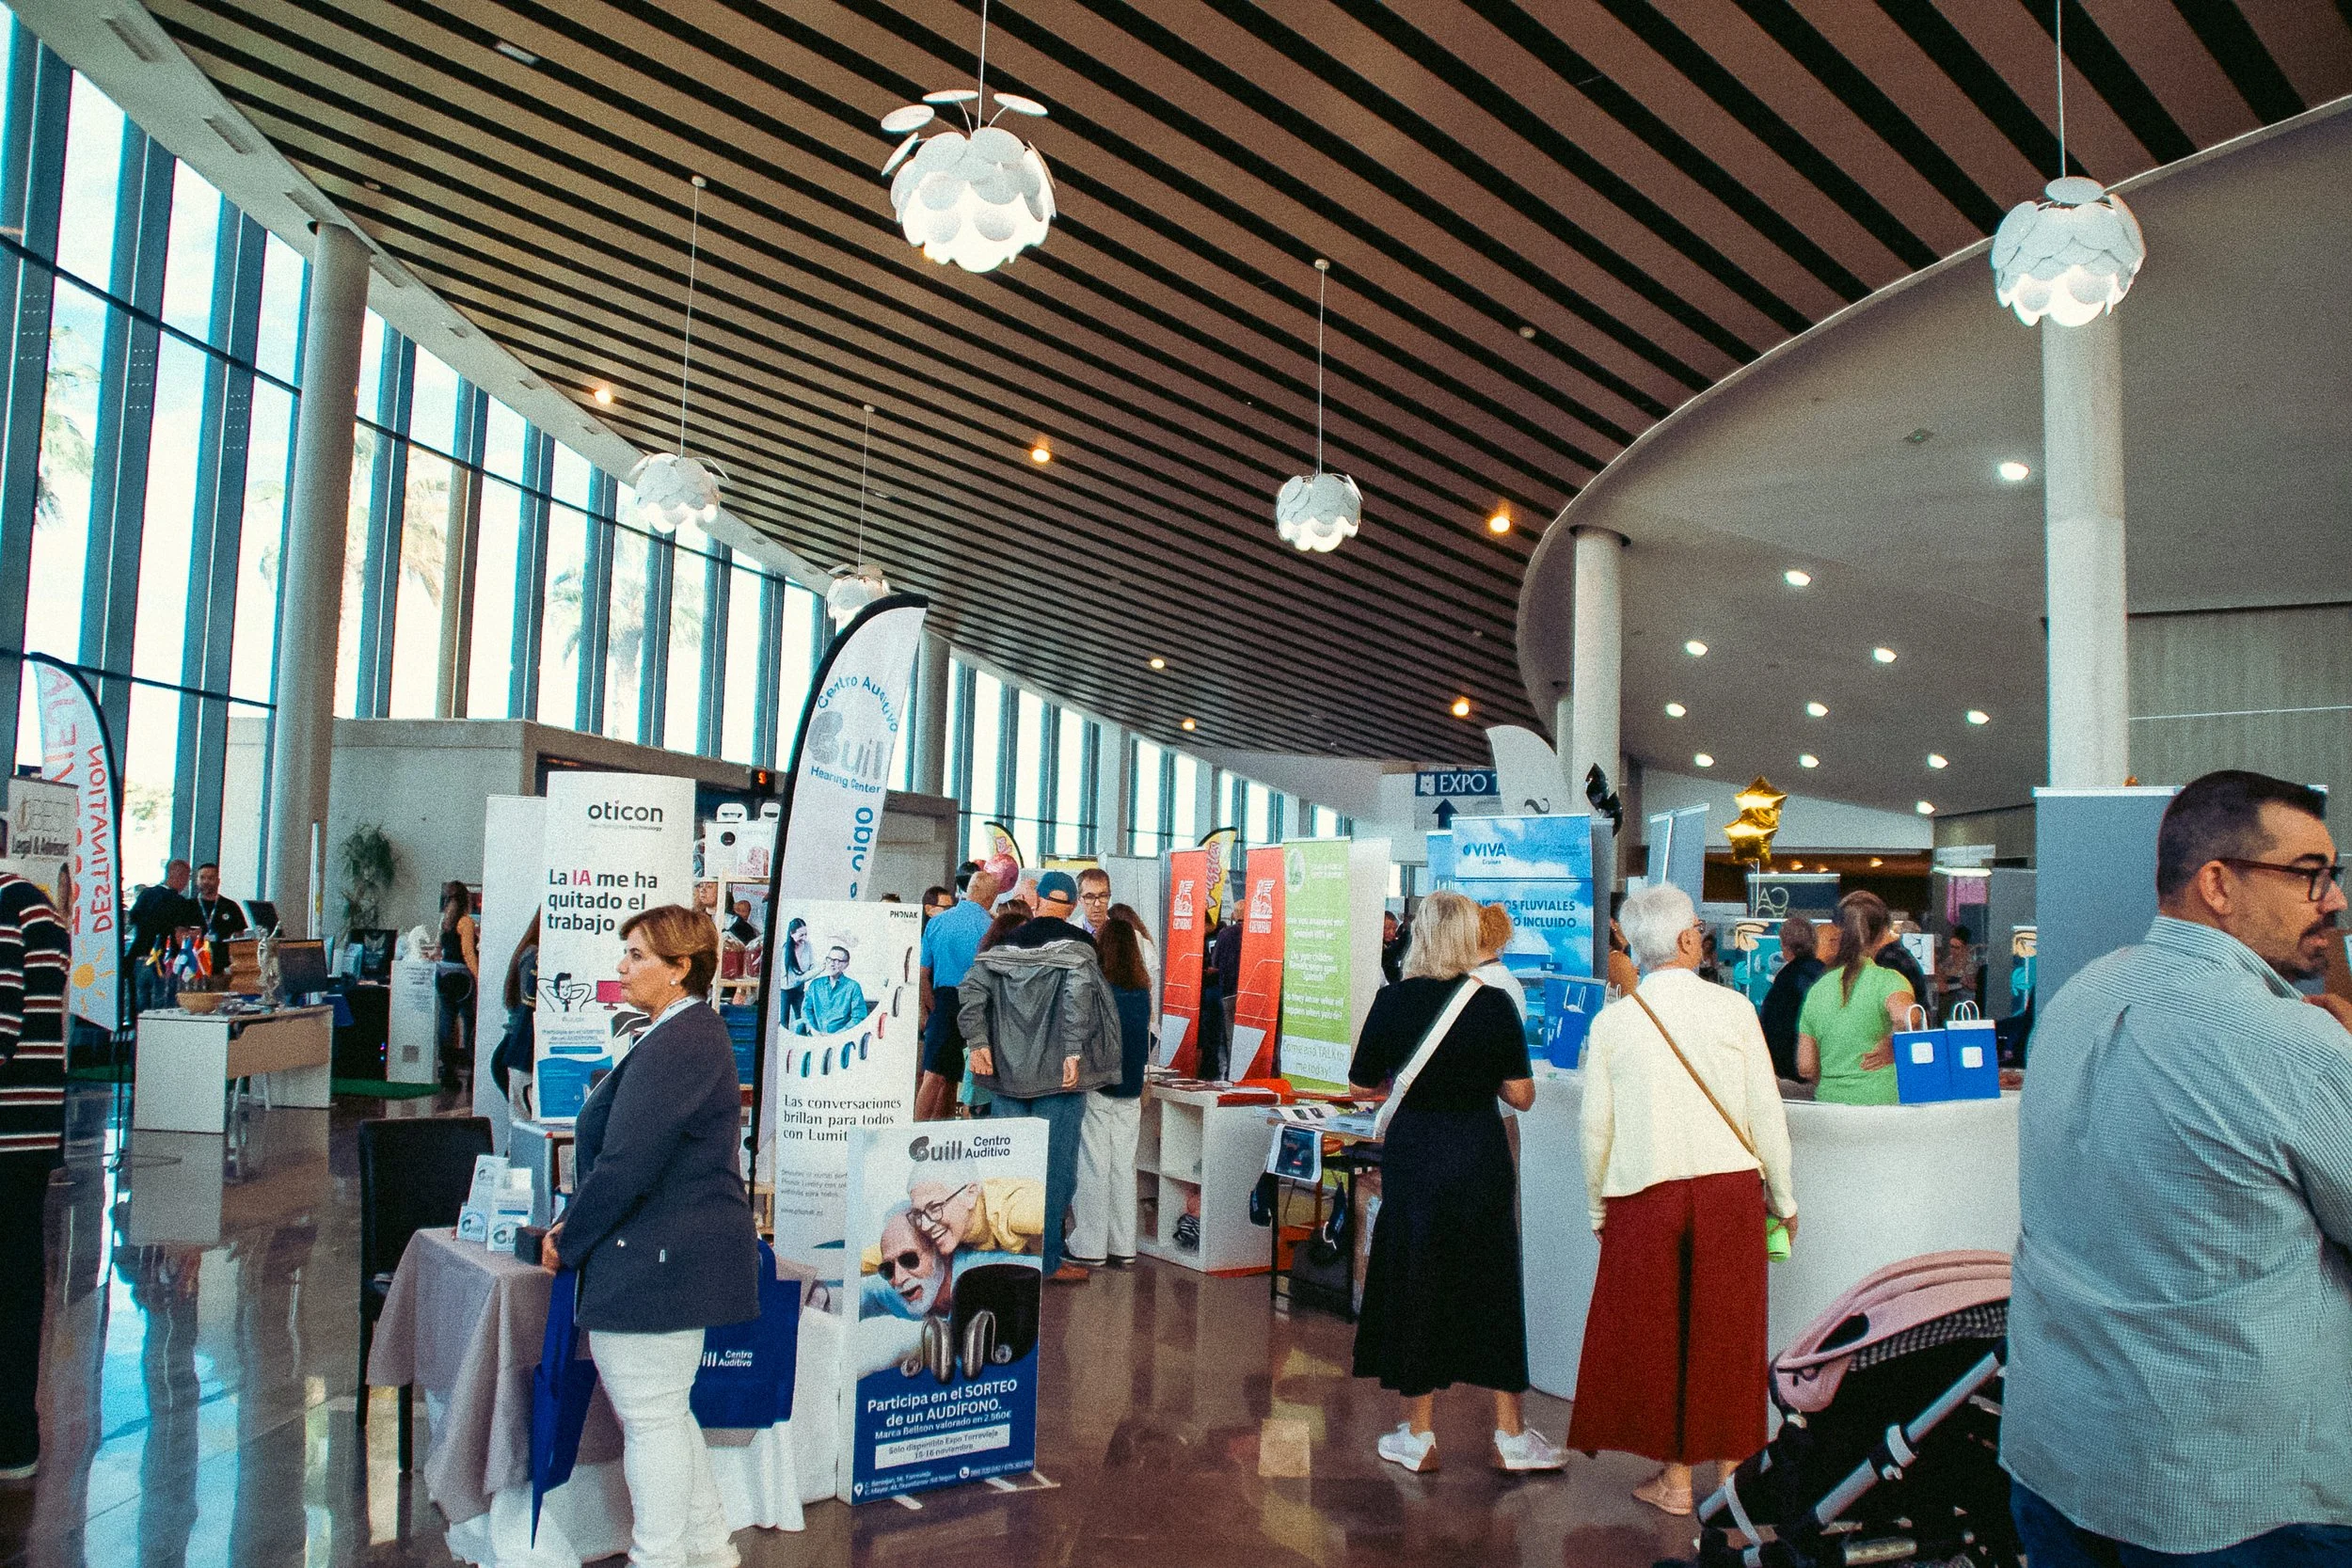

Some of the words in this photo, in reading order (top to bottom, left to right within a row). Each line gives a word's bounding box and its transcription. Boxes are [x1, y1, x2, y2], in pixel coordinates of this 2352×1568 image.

[816, 675, 858, 709] Centro
[810, 765, 849, 789] Hearing
[850, 778, 882, 794] Center
[1439, 773, 1487, 793] EXPO
[587, 800, 663, 822] oticon
[1473, 843, 1507, 857] VIVA
[548, 868, 567, 885] La
[572, 869, 592, 886] IA
[596, 873, 628, 887] me
[634, 871, 658, 888] ha
[548, 891, 623, 911] quitado
[628, 894, 646, 910] el
[1520, 900, 1576, 911] FLUVIALES
[547, 912, 615, 936] trabajo
[1523, 917, 1577, 928] INCLUIDO
[785, 1094, 803, 1107] Las
[807, 1098, 901, 1110] conversaciones
[784, 1110, 822, 1125] brillan
[828, 1117, 856, 1128] para
[863, 1114, 895, 1126] todos
[784, 1130, 803, 1140] con
[974, 1135, 1010, 1147] Centro
[965, 1148, 1010, 1159] Auditivo
[718, 1358, 752, 1368] Auditivo
[725, 1350, 753, 1359] Centro
[867, 1393, 929, 1414] Participa
[931, 1392, 947, 1403] en
[950, 1386, 962, 1401] el
[965, 1379, 1018, 1399] SORTEO
[885, 1413, 903, 1428] de
[906, 1412, 923, 1425] un
[927, 1398, 1002, 1421] AUDÍFONO.
[875, 1428, 901, 1440] Marca
[935, 1418, 971, 1431] valorado
[973, 1417, 983, 1425] en
[906, 1438, 944, 1452] disponible
[946, 1435, 962, 1448] Expo
[964, 1429, 998, 1442] Torrevieja
